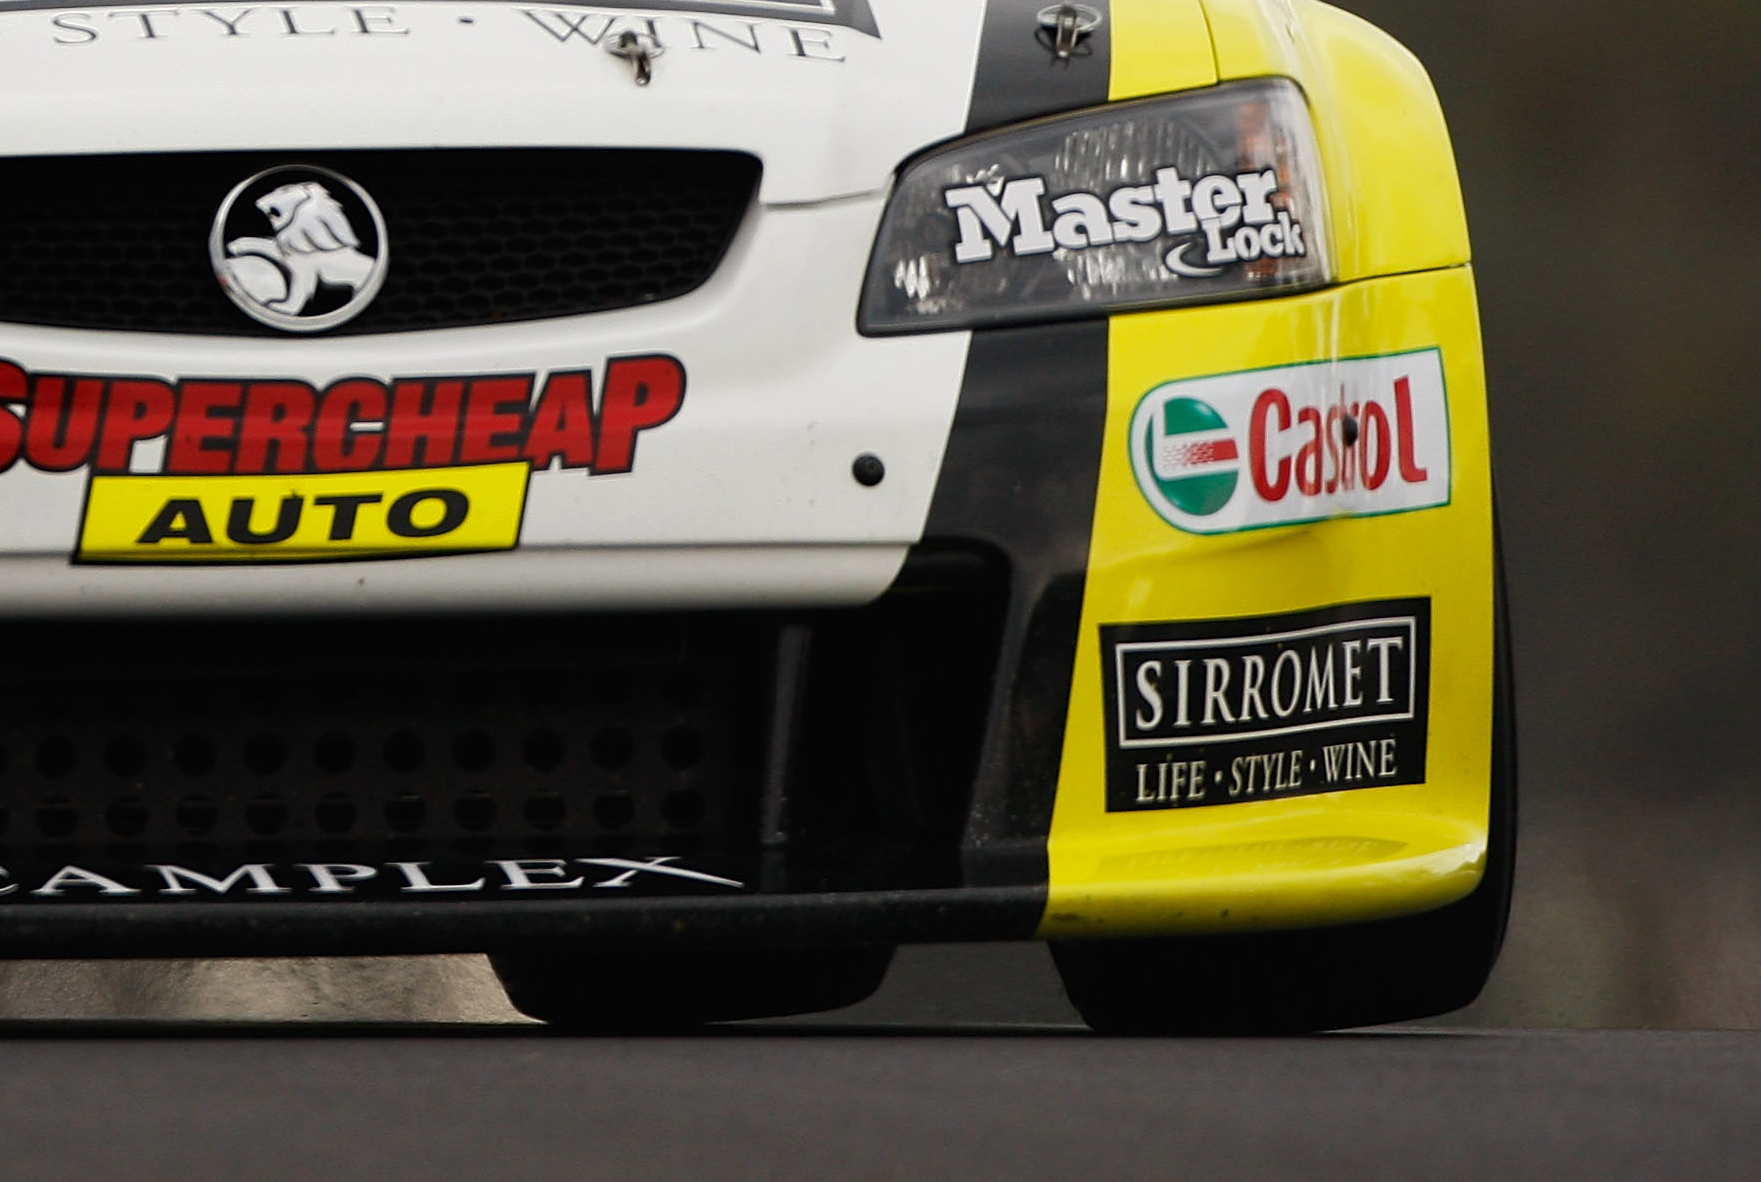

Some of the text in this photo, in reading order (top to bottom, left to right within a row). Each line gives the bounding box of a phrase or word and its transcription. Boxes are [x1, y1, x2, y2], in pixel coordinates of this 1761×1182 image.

[51, 5, 411, 44] STYLE
[945, 166, 1279, 263] Master
[1204, 211, 1306, 262] Lock
[137, 489, 470, 545] AUTO
[1135, 636, 1403, 732] SIRROMET
[1135, 738, 1399, 804] LIFE STYLE WINE
